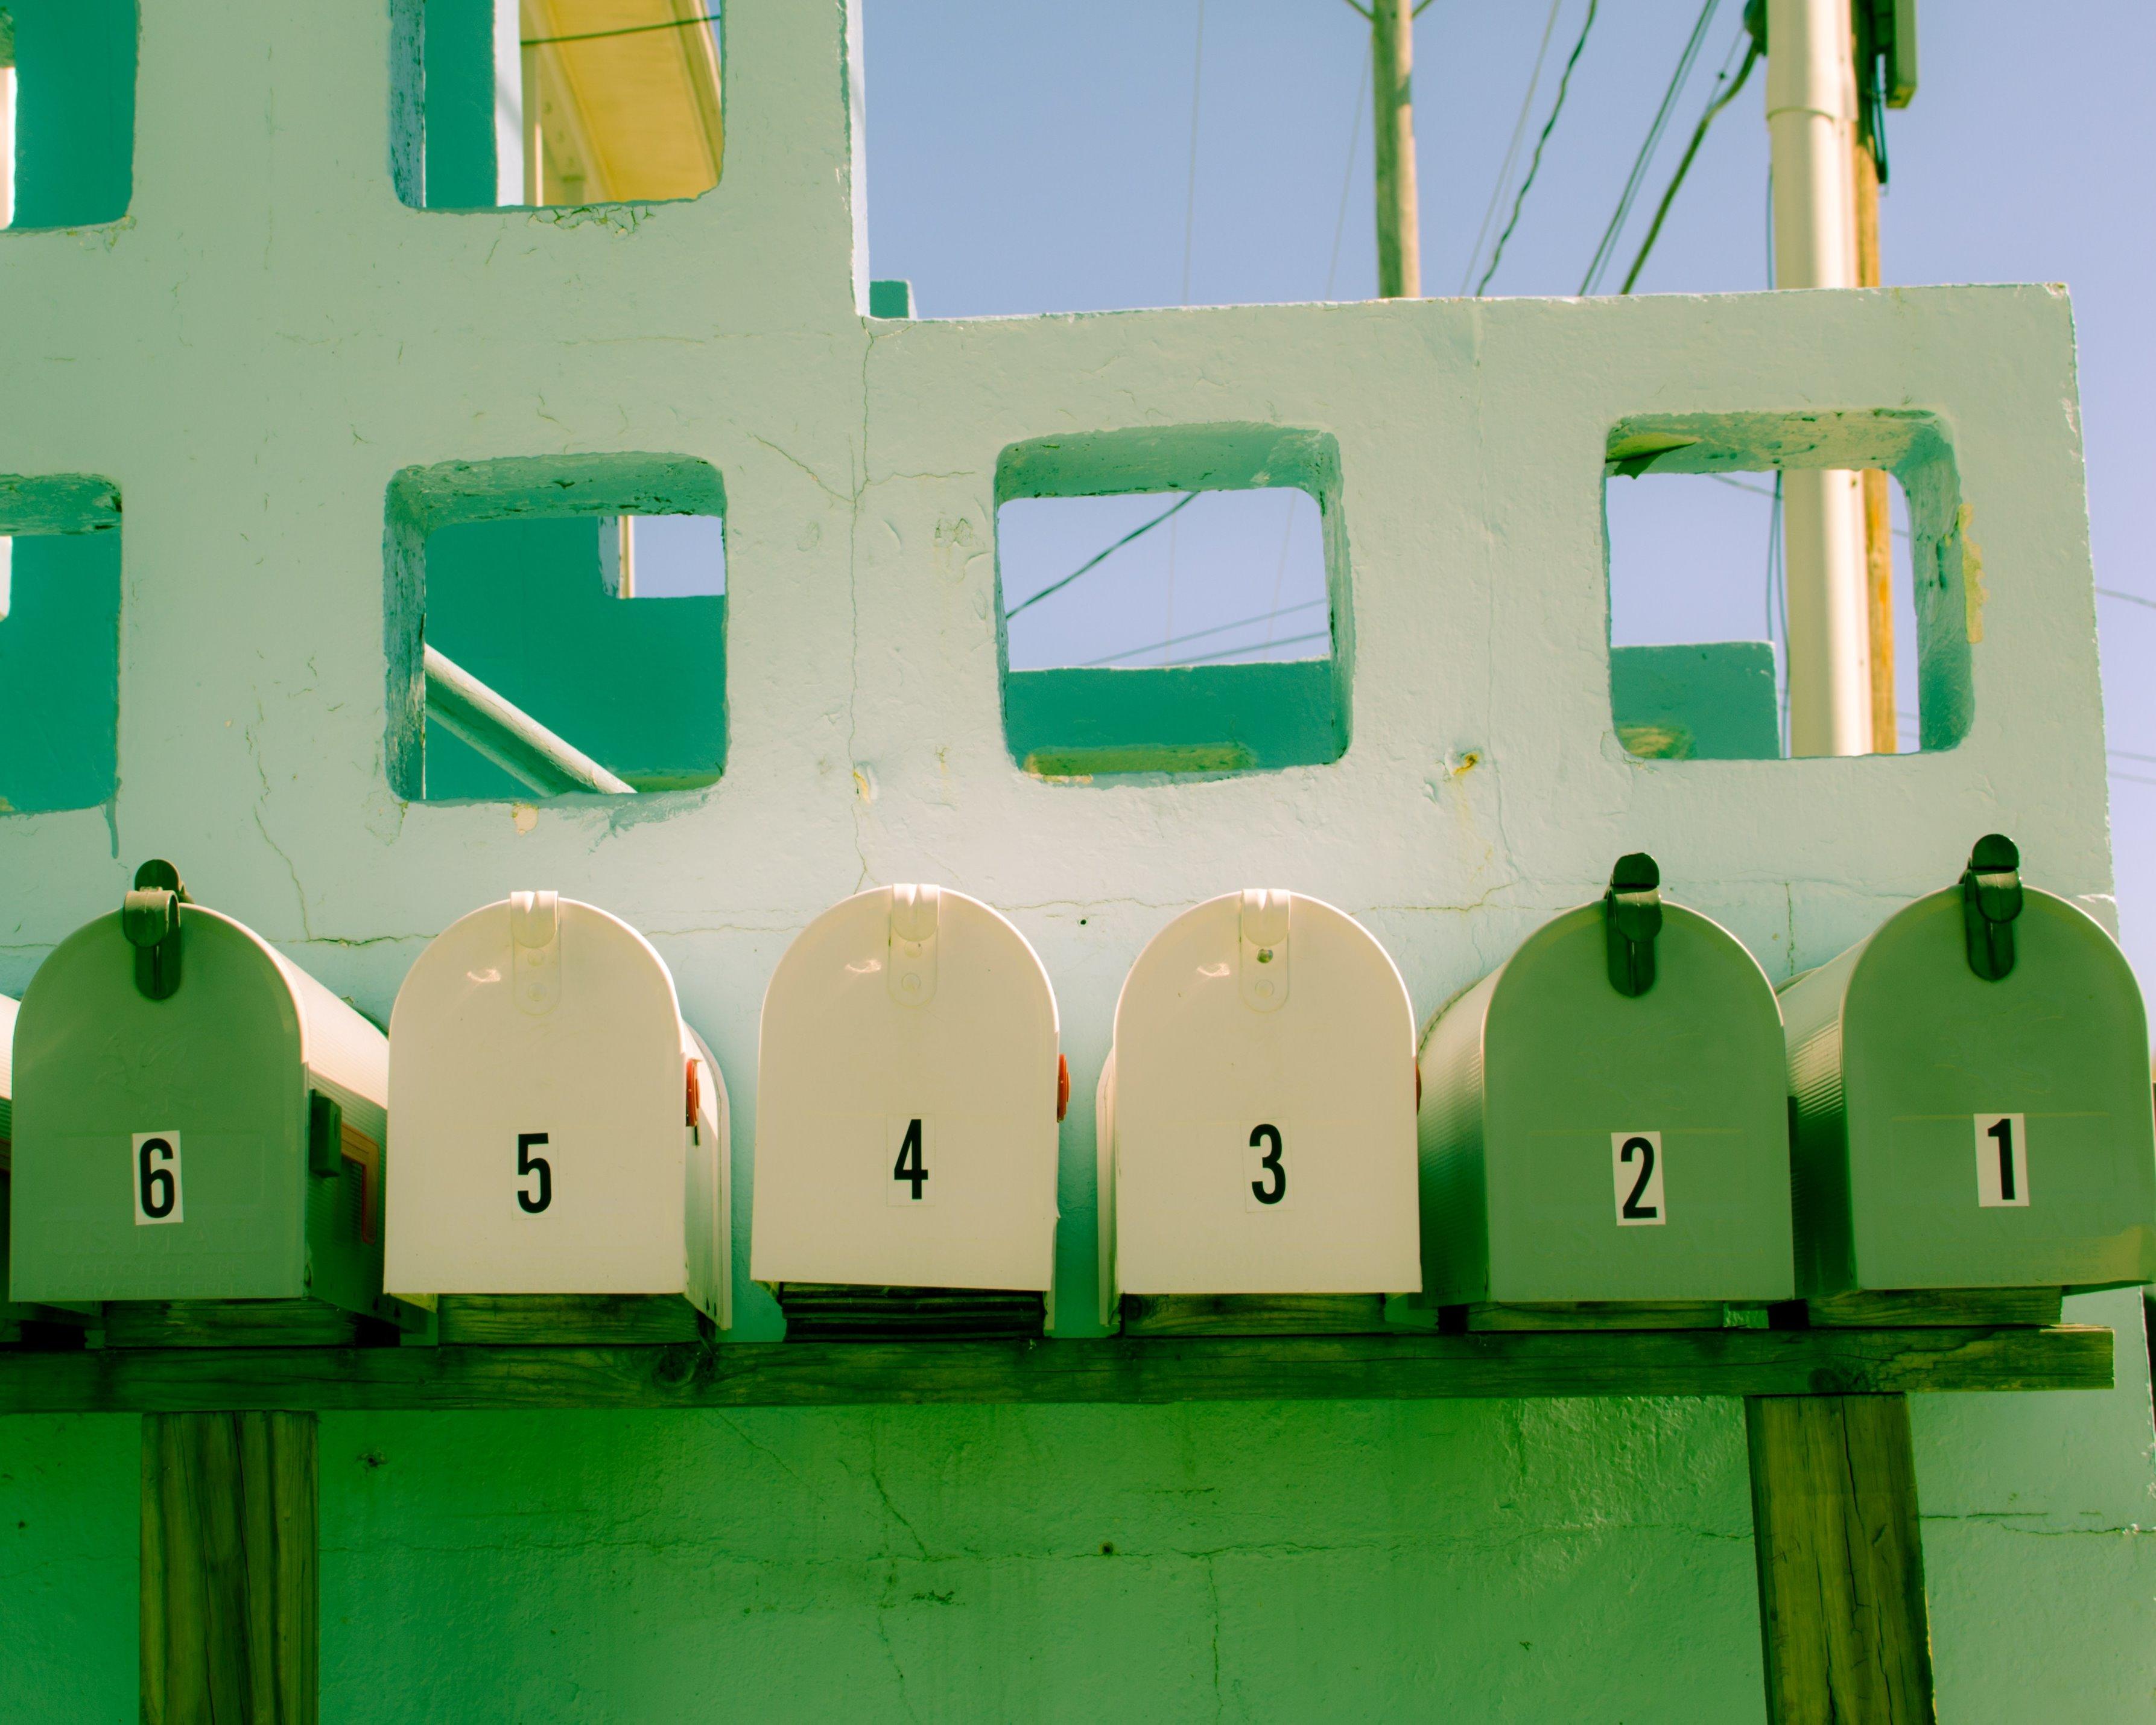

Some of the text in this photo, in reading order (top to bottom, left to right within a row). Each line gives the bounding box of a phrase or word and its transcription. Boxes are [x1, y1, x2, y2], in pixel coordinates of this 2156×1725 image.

[139, 1137, 175, 1219] 6
[517, 1133, 552, 1214] 5
[894, 1119, 928, 1199] 4
[1249, 1123, 1286, 1204] 3
[1620, 1137, 1657, 1219] 2
[1987, 1118, 2015, 1200] 1
